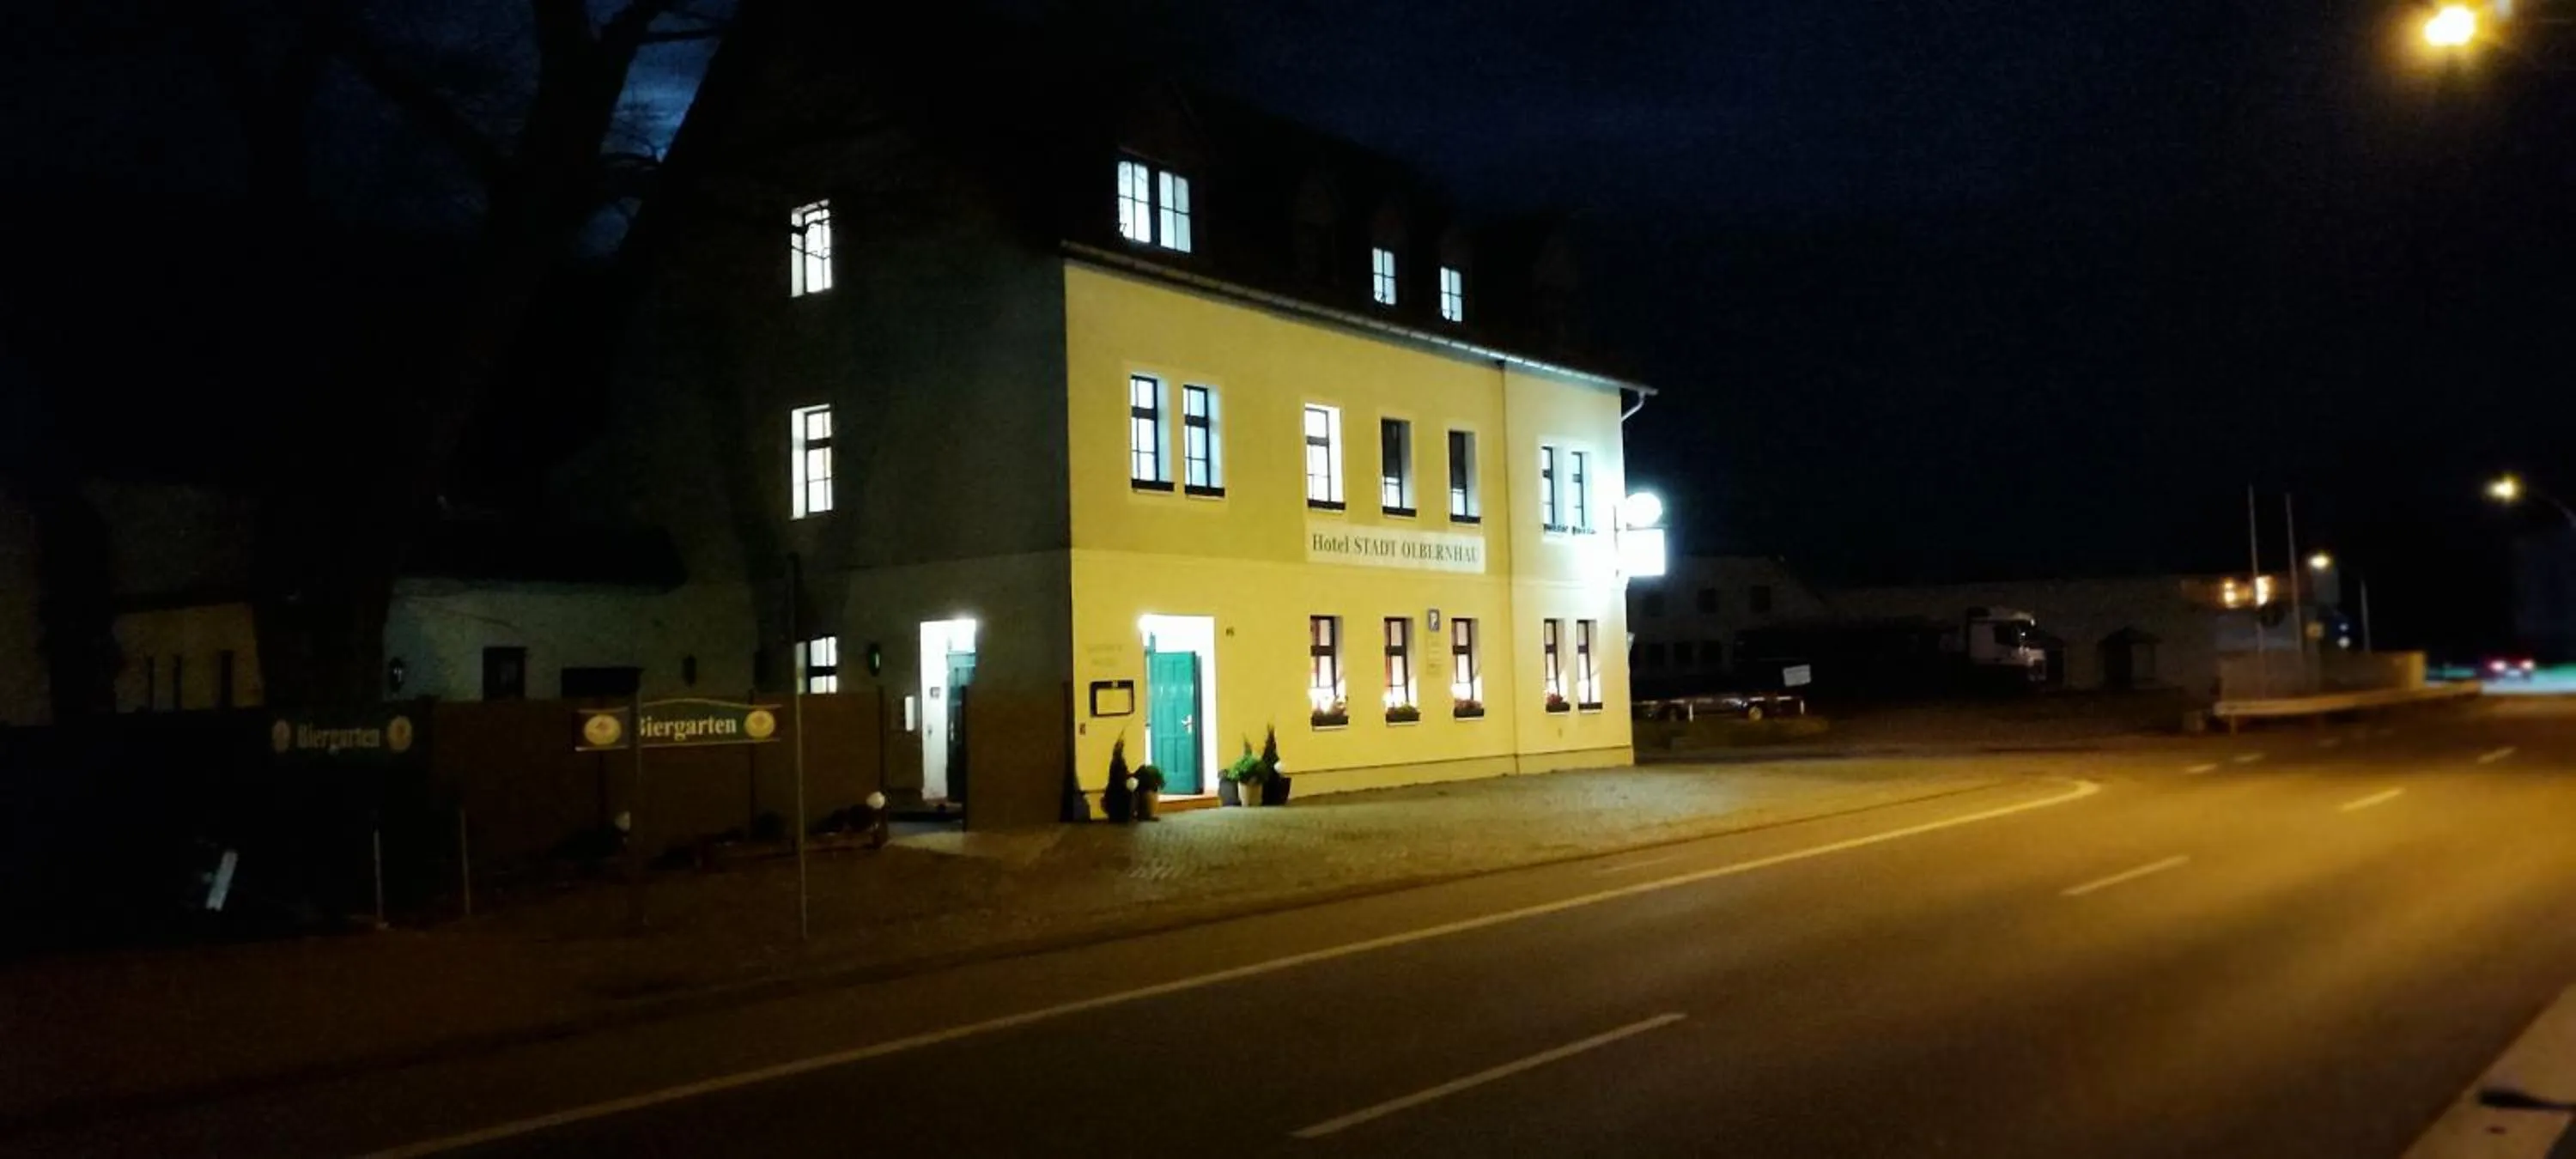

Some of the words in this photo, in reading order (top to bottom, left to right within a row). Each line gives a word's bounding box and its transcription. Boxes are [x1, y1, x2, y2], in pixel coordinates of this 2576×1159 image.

[1312, 533, 1349, 554] Hotel
[1353, 536, 1397, 557] STADT
[1401, 541, 1481, 563] OLBERNHAU
[296, 719, 380, 755] Biergarten
